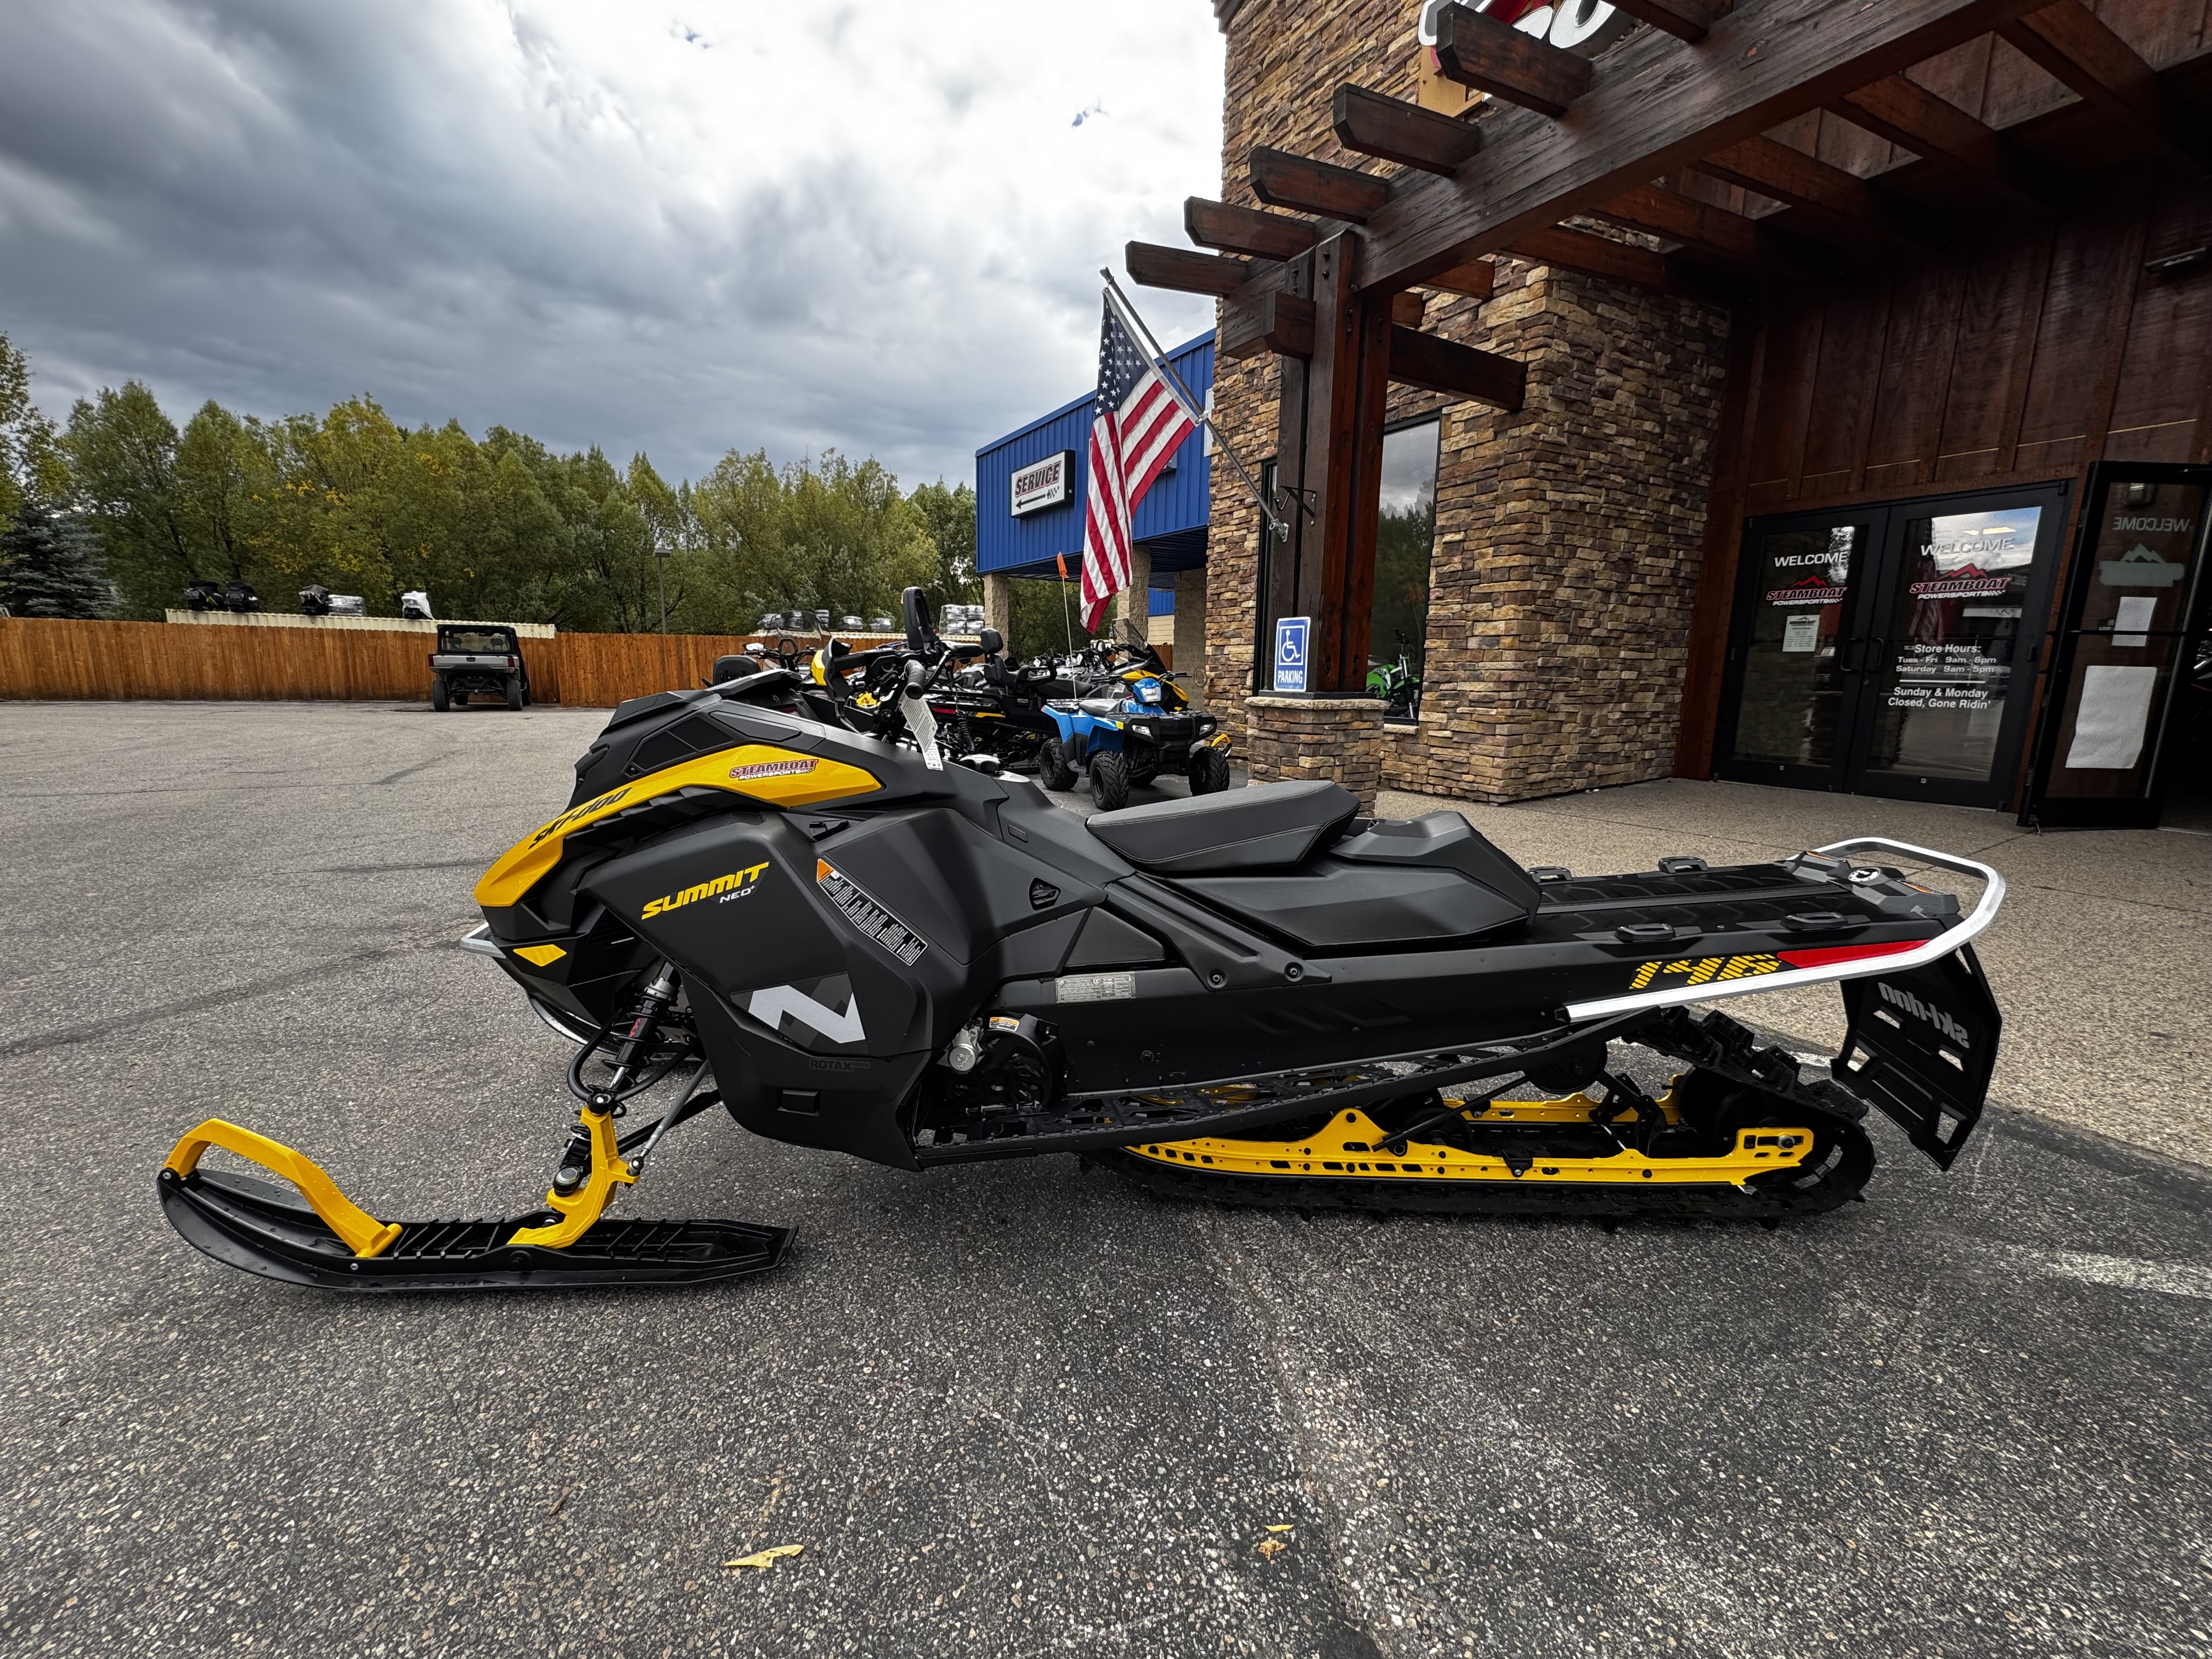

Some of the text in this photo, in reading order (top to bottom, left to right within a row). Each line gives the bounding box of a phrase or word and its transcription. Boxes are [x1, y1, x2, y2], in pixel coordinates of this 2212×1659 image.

[1015, 460, 1062, 498] SERVICE
[1921, 538, 2014, 556] WELCOME
[1774, 551, 1848, 567] WELCOME
[1909, 577, 2012, 594] STEAMBOAT
[1766, 586, 1848, 601] STEAMBOAT
[1917, 591, 1988, 599] POWERSPORTS
[1914, 644, 1982, 653] Store Hours:
[1895, 665, 1937, 674] Saturday
[1277, 670, 1303, 684] PARKING
[1893, 687, 1988, 699] Sunday & Monday
[1888, 697, 1991, 709] Closed, Gone Ridin'
[729, 759, 819, 778] STEAMBOAT
[739, 769, 801, 781] POWERSPORTS
[641, 861, 769, 920] SUMMIT
[1629, 954, 1782, 989] 146
[810, 1059, 853, 1071] ROTAX
